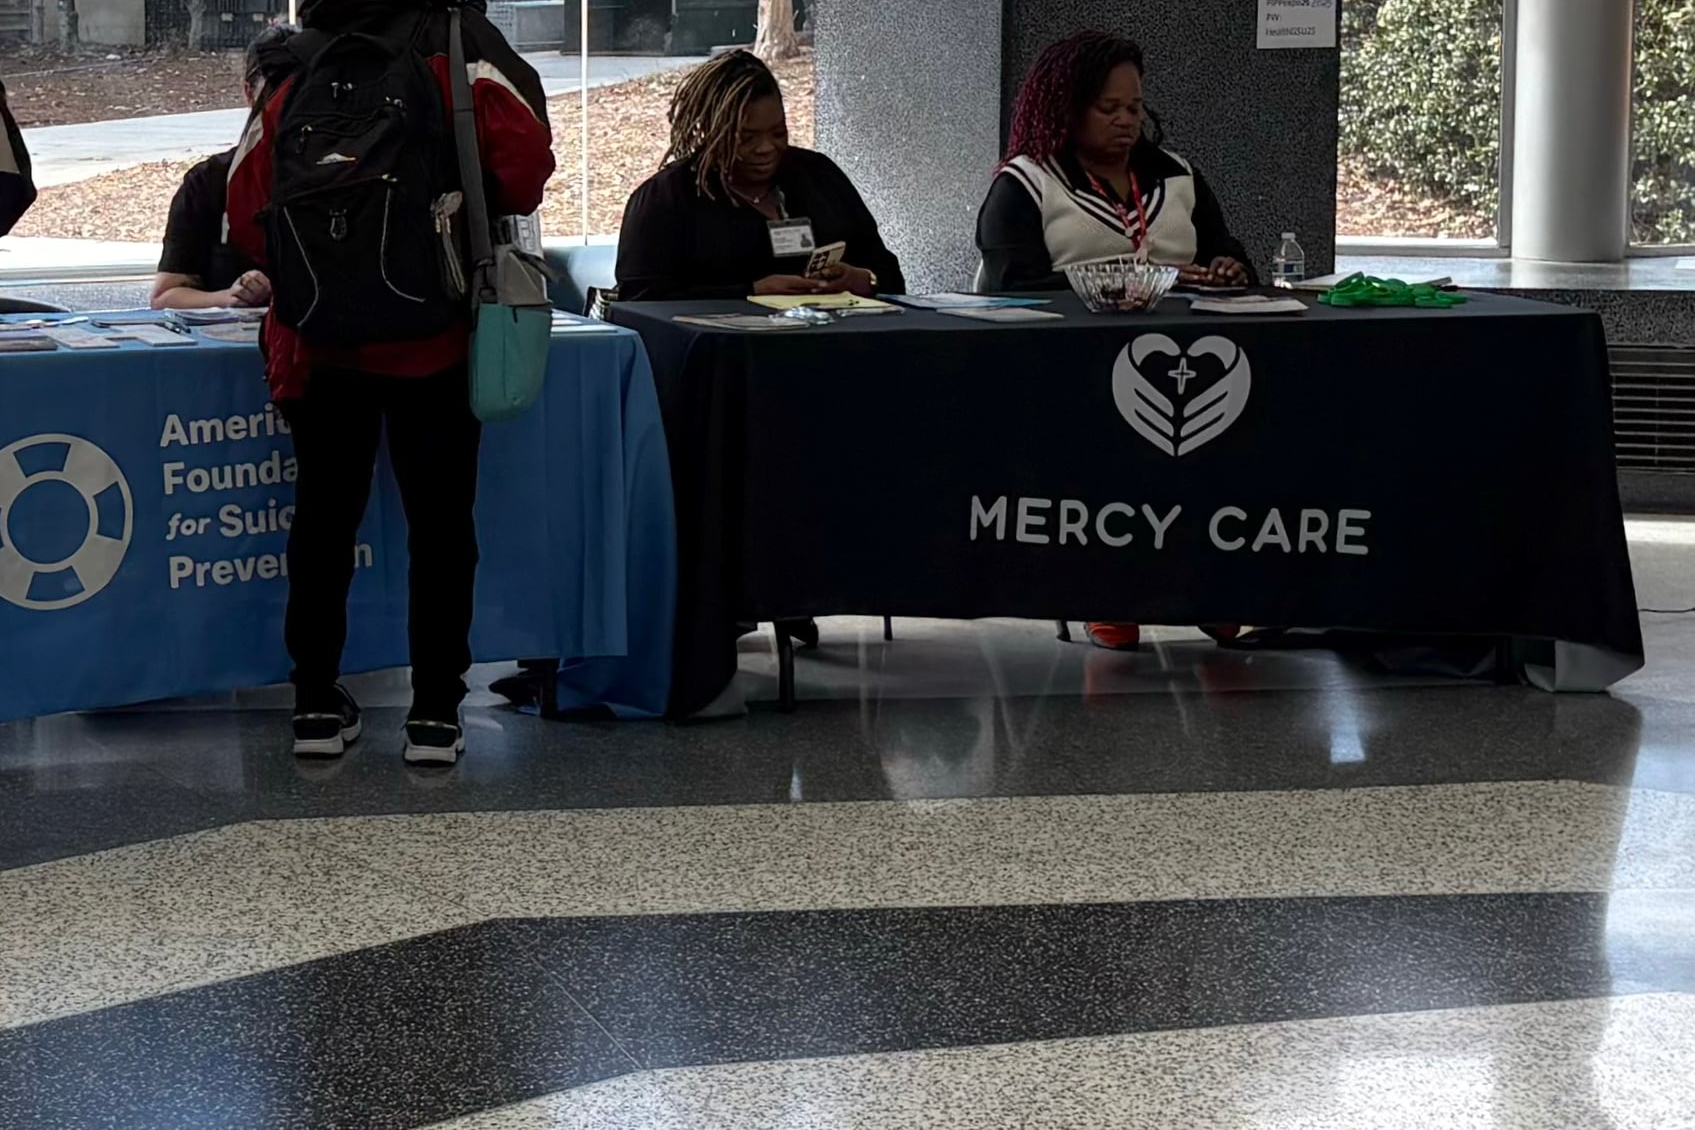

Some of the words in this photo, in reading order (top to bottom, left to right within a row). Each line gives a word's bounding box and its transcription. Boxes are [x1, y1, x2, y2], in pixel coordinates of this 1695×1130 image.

[163, 450, 299, 495] Founda
[166, 513, 211, 541] for
[218, 498, 296, 538] Suic
[969, 495, 1182, 550] MERCY
[1208, 506, 1372, 555] CARE
